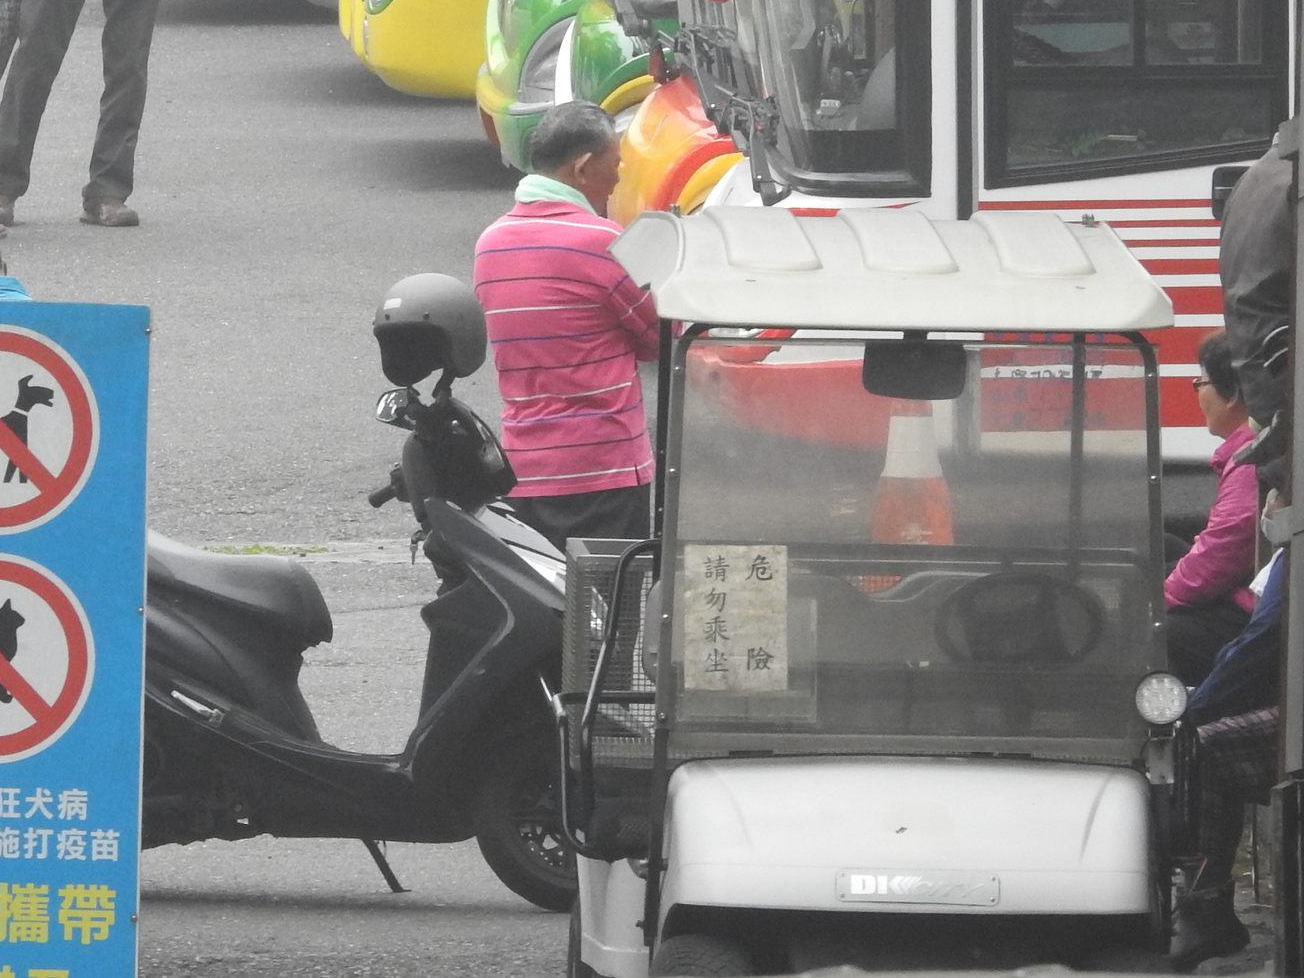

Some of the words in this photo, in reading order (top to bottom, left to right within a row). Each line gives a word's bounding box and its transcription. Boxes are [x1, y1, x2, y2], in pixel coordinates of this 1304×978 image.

[704, 555, 730, 672] 請勿乘坐
[746, 554, 774, 671] 危險
